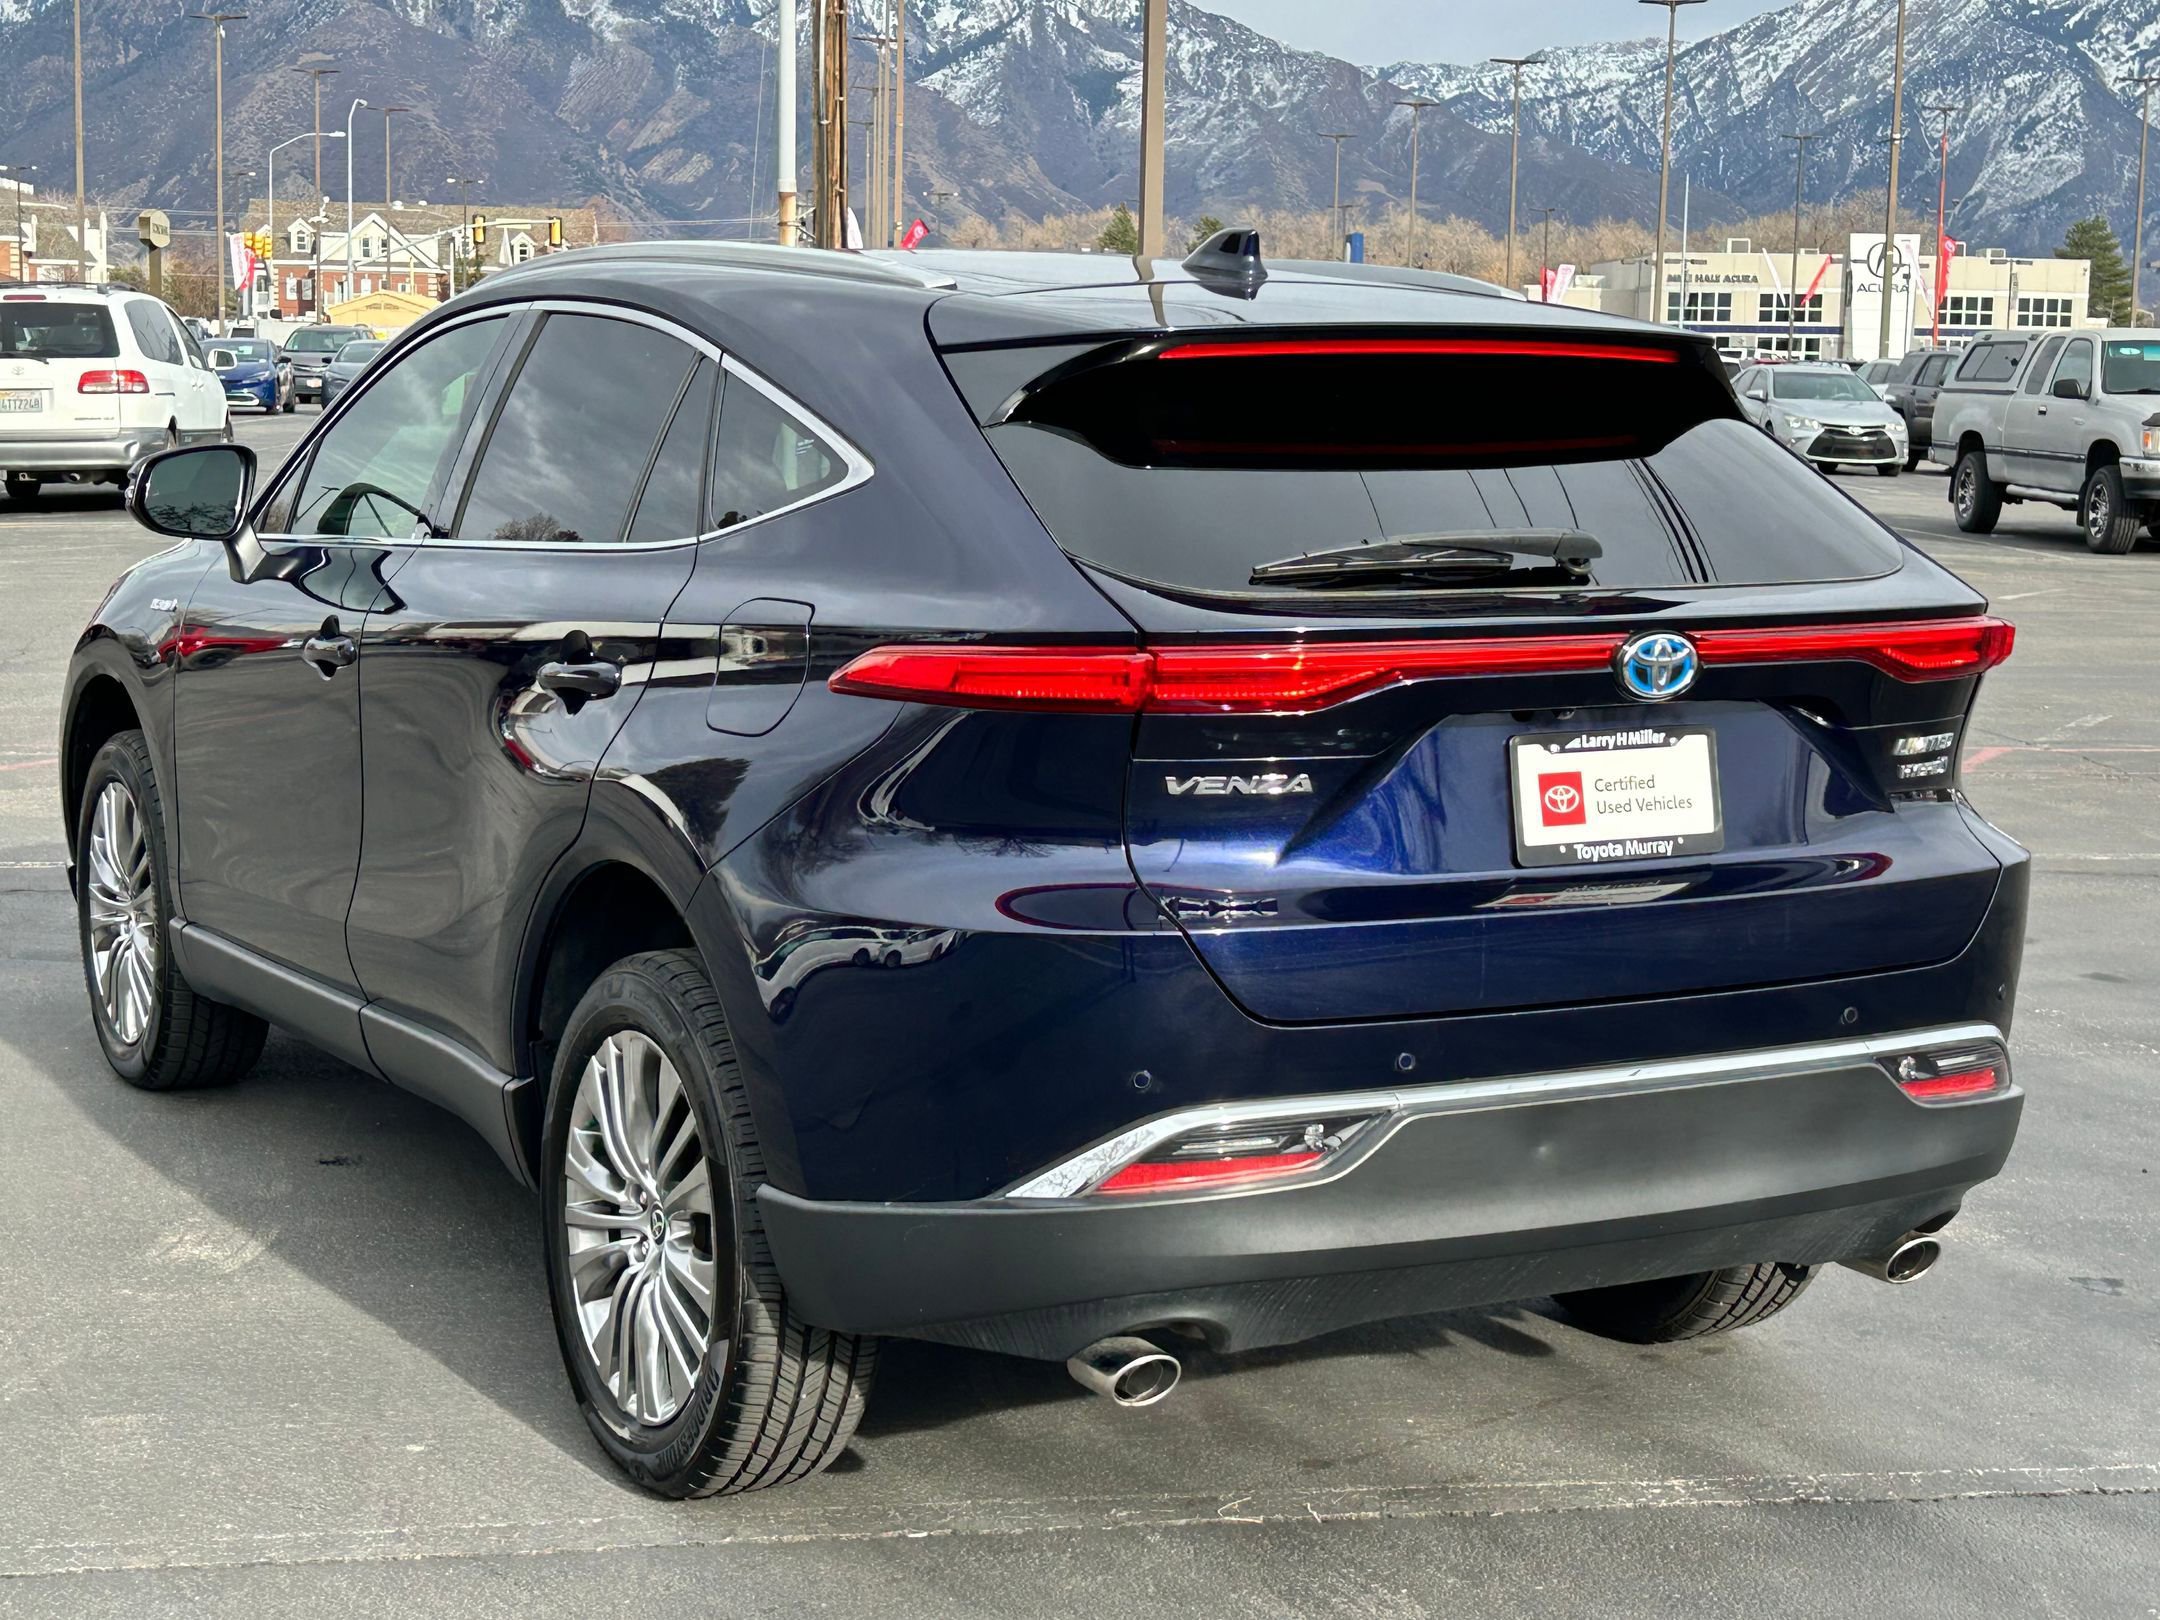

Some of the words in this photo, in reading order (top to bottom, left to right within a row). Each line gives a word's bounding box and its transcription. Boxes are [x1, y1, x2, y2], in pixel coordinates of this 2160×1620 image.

[1582, 734, 1616, 750] Larry
[1617, 731, 1627, 746] H
[1628, 729, 1666, 746] Miller
[1165, 766, 1314, 795] VENZA
[1594, 774, 1656, 793] Certified
[1597, 798, 1632, 815] Used
[1635, 794, 1693, 812] Vehicles
[1573, 841, 1624, 862] Toyota
[1625, 839, 1674, 857] Murray
